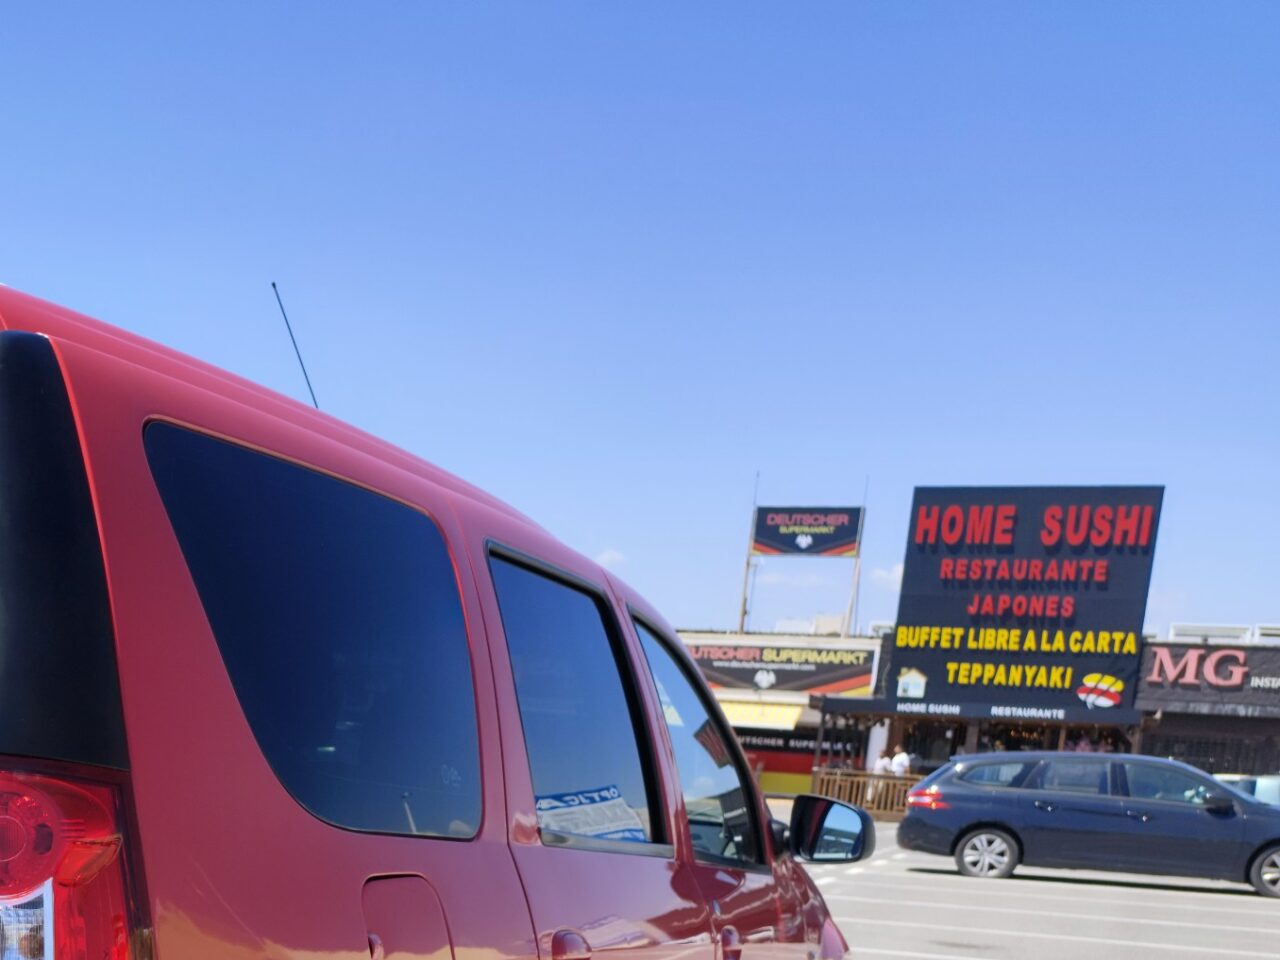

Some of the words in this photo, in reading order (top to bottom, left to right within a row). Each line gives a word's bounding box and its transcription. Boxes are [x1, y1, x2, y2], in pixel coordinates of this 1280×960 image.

[766, 513, 849, 525] DEUTSCHER
[778, 525, 836, 533] SUPERMARKT
[914, 505, 1017, 545] HOME
[1040, 505, 1153, 546] SUSHI
[939, 558, 1109, 581] RESTAURANTE
[967, 595, 1075, 617] JAPONES
[895, 626, 964, 648] BUFFET
[967, 627, 1021, 650] LIBRE
[1023, 630, 1038, 651] A
[1040, 630, 1066, 652] LA
[1069, 631, 1137, 654] CARTA
[688, 646, 761, 660] UTSCHER
[762, 647, 868, 665] SUPERMARKT
[1145, 645, 1250, 686] MG
[946, 662, 1073, 688] TEPPANYAKI
[896, 702, 927, 713] HOME
[928, 703, 961, 715] SUSHI
[990, 706, 1066, 720] RESTAURANTE
